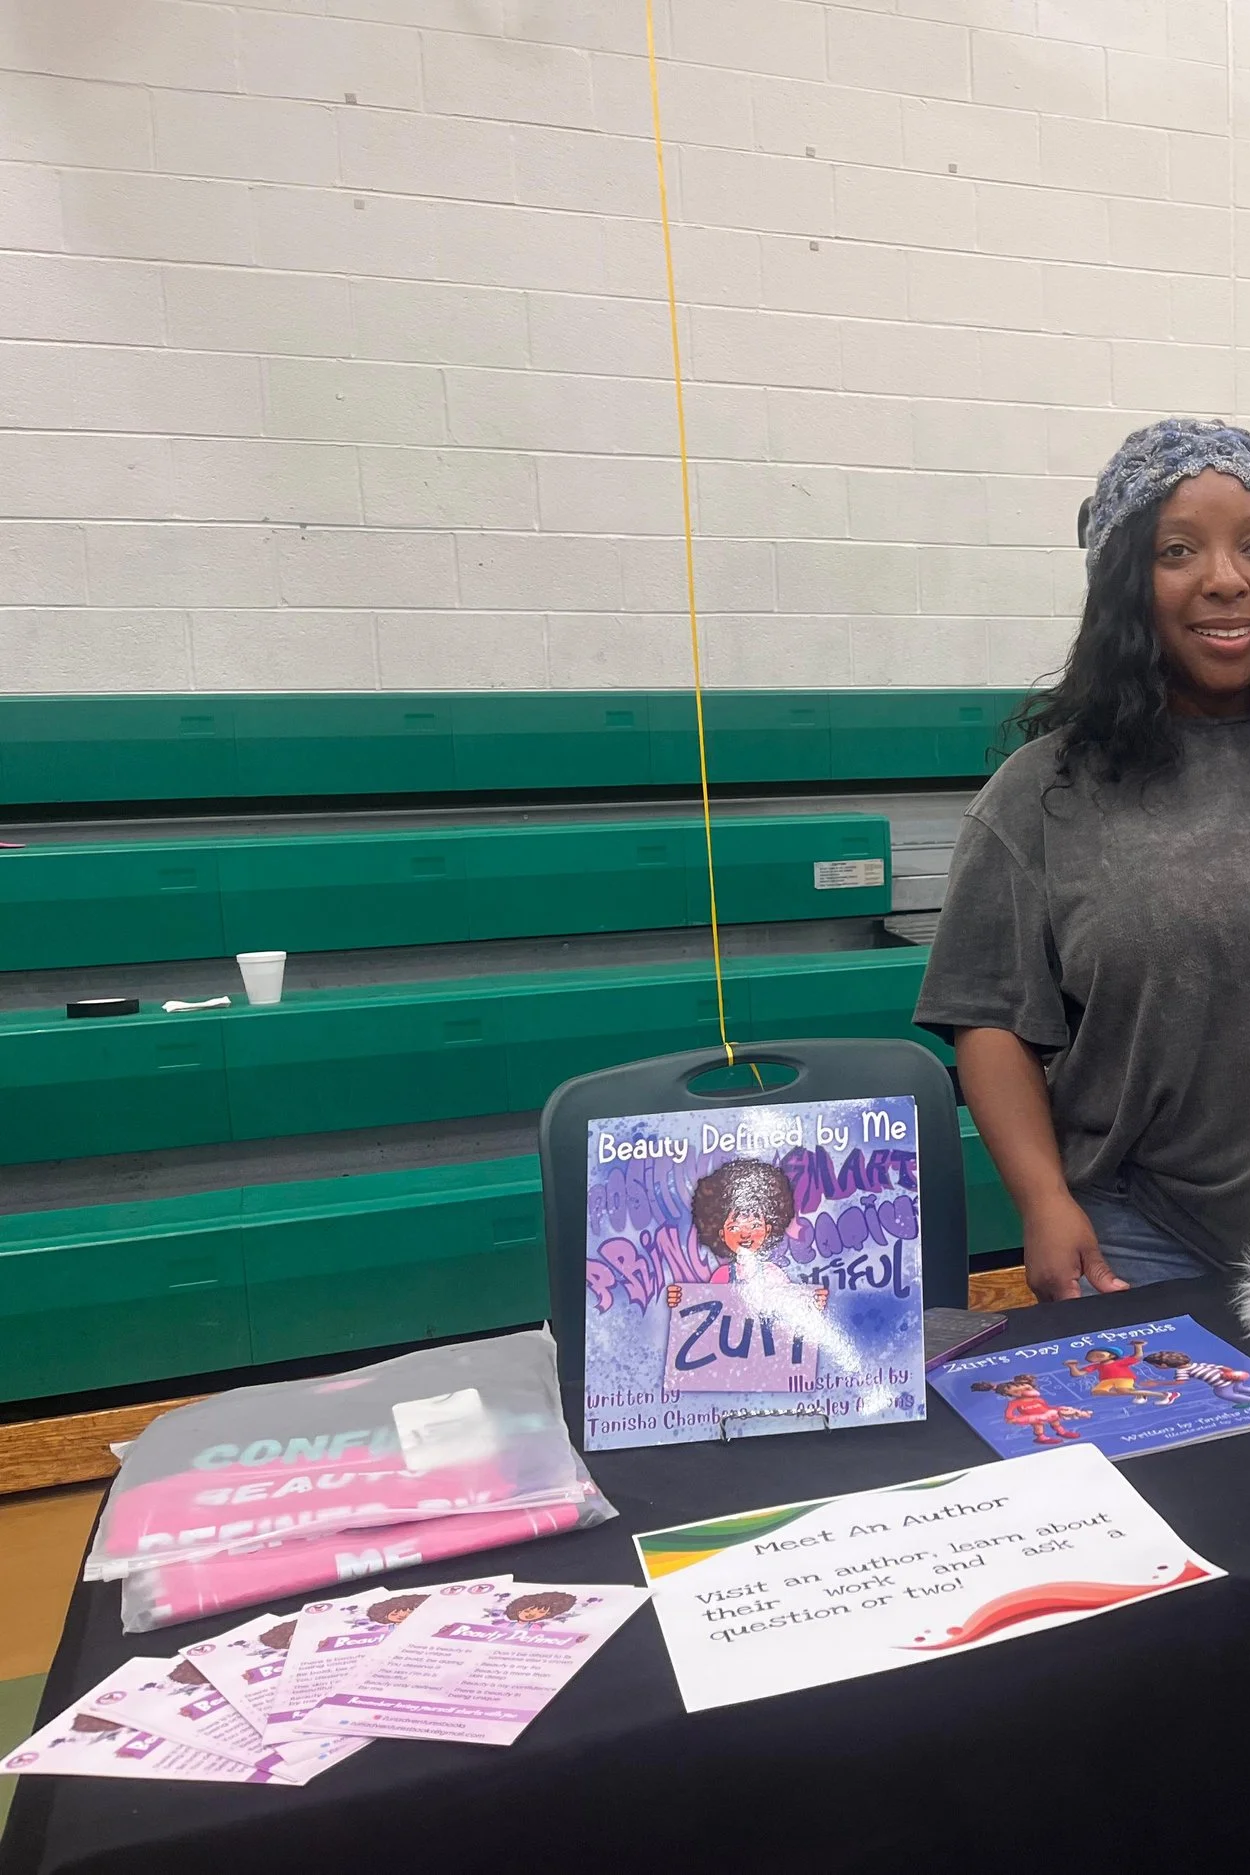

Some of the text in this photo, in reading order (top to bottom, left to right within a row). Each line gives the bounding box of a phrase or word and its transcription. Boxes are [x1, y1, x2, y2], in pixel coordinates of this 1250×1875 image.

[598, 1110, 907, 1165] Beauty Defined by Me
[1015, 1344, 1060, 1359] Day
[1070, 1336, 1094, 1350] of
[1097, 1323, 1176, 1343] Pranks
[660, 1385, 681, 1405] by
[587, 1413, 656, 1438] Tanisha
[753, 1495, 1011, 1557] Meet An Author
[783, 1571, 822, 1589] an
[946, 1531, 1025, 1554] learn
[1034, 1511, 1114, 1538] about
[700, 1527, 1127, 1624] their work and ask a
[860, 1592, 896, 1610] or
[902, 1576, 965, 1600] two!
[450, 1624, 573, 1646] Beauty Defined
